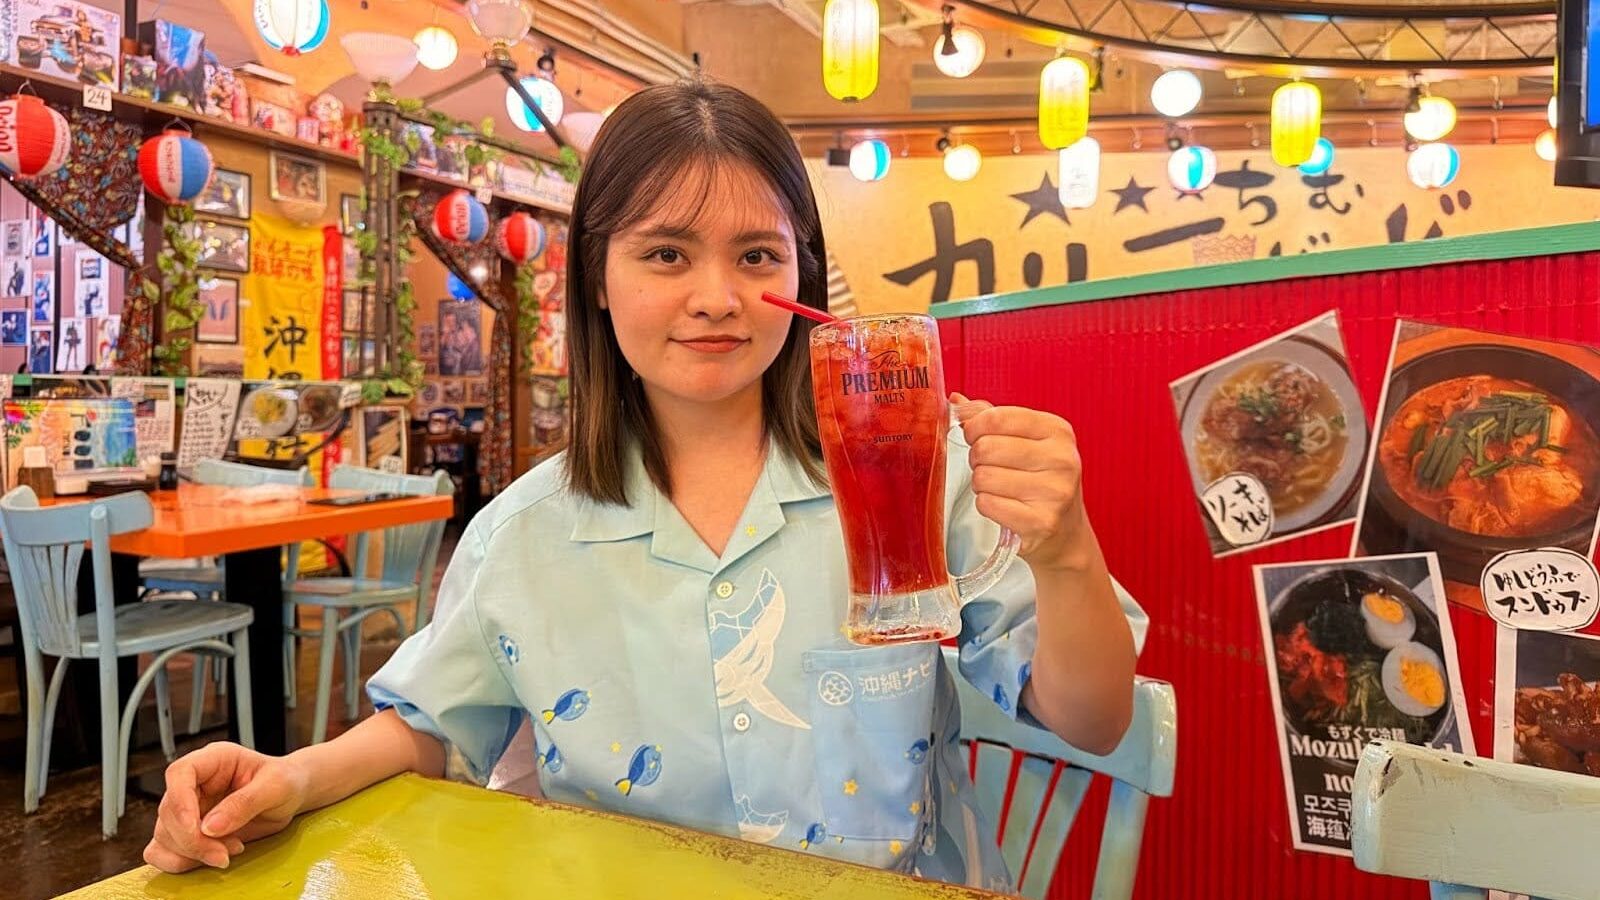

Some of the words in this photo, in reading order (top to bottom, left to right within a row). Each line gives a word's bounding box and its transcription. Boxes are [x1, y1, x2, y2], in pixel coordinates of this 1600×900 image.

[87, 88, 107, 105] 24
[841, 366, 929, 396] PREMIUM
[874, 392, 905, 405] MALTS
[1491, 563, 1581, 592] ゆしどうふで
